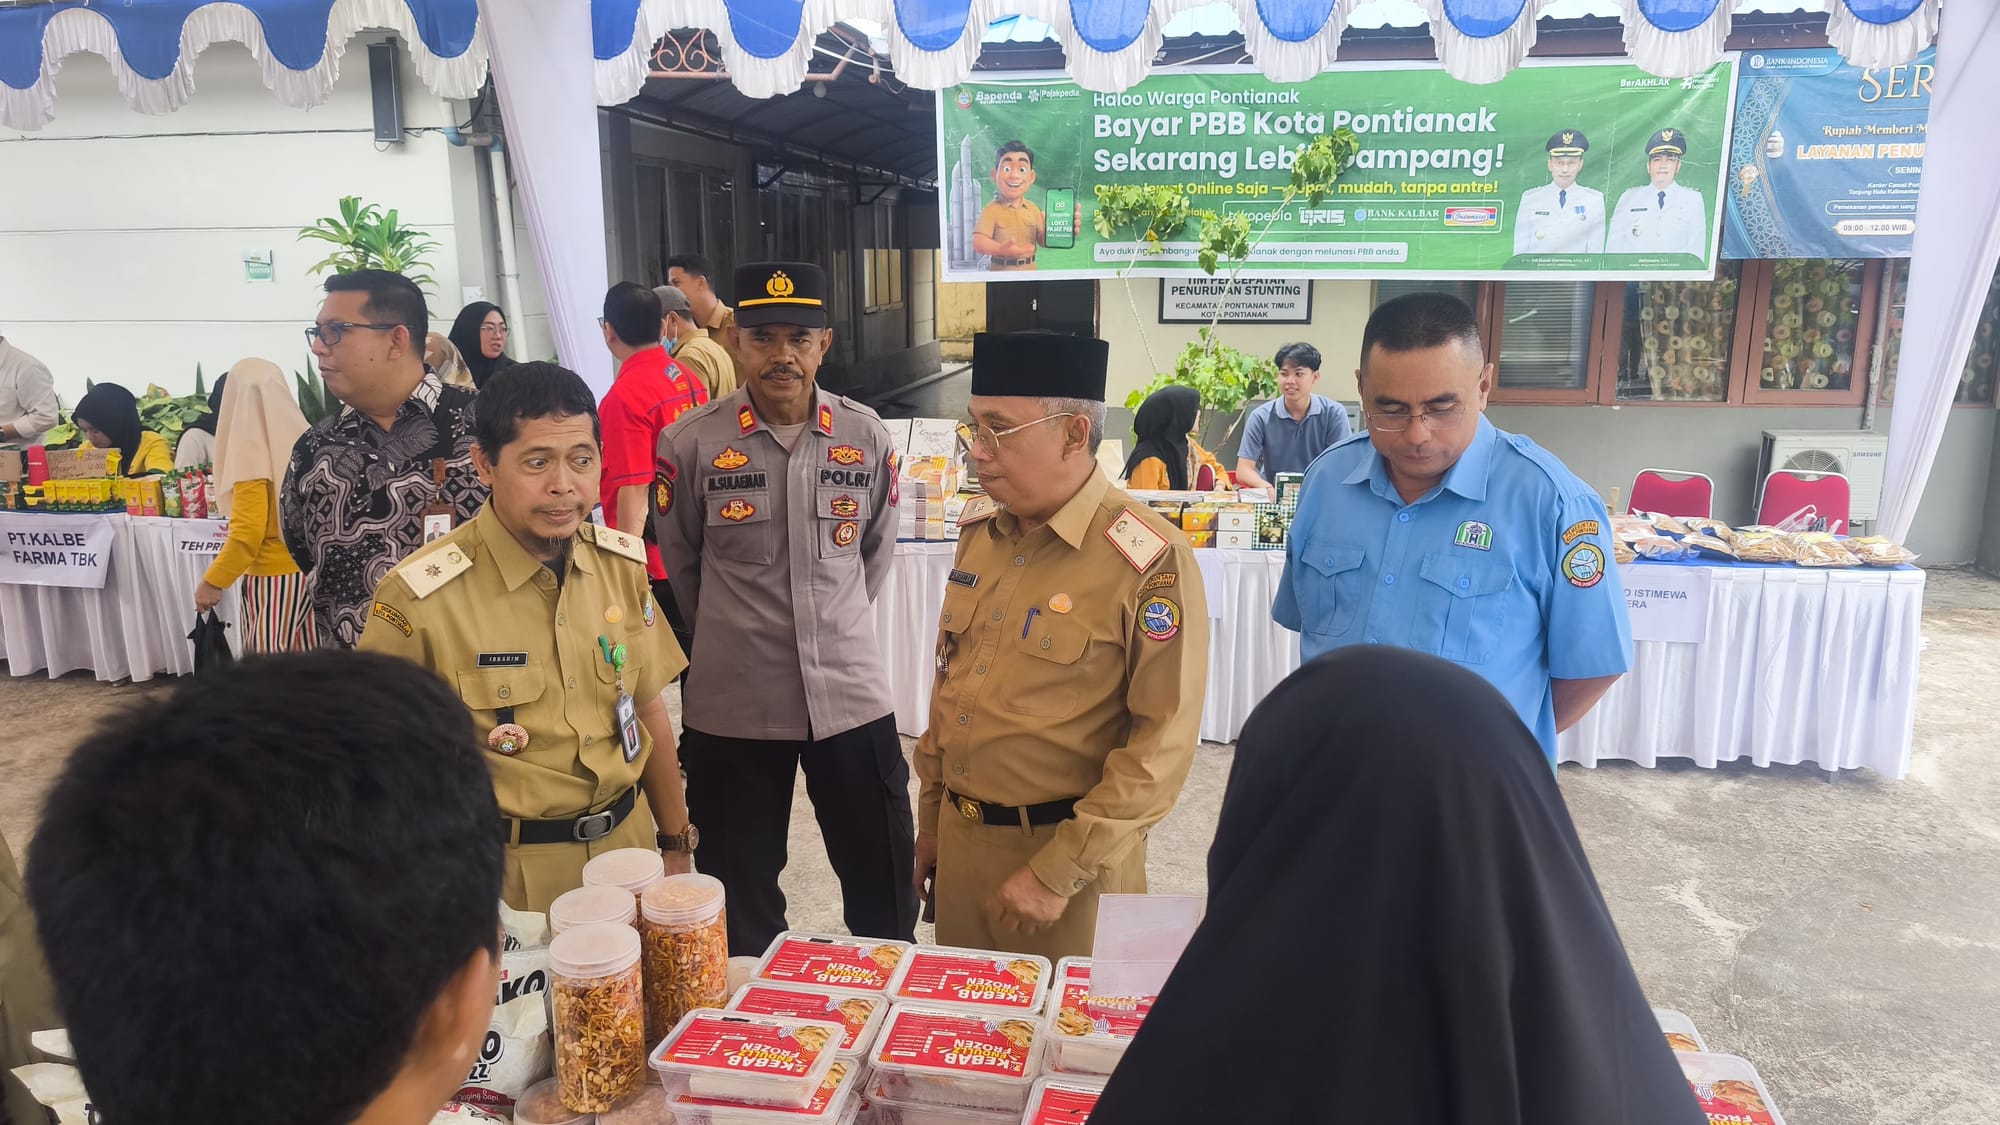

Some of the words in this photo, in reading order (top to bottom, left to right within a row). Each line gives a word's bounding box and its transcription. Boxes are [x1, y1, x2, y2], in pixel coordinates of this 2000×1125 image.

[1787, 57, 1829, 65] INDONESIA
[1619, 78, 1671, 87] BerAKHLAK
[975, 91, 1023, 103] Bapenda
[1093, 92, 1143, 107] Haloo
[1147, 91, 1206, 109] Warga
[1210, 89, 1300, 104] Pontianak
[1094, 114, 1183, 145] Bayar
[1190, 111, 1247, 136] PBB
[1254, 111, 1325, 135] Kota
[1333, 106, 1497, 133] Pontianak
[1823, 125, 1862, 137] Rupiah
[1864, 124, 1914, 135] Memberi
[1796, 143, 1875, 159] LAYANAN
[1094, 147, 1238, 179] Sekarang
[1186, 183, 1234, 196] Online
[1236, 183, 1268, 198] Saja
[1338, 181, 1398, 196] mudah,
[1401, 181, 1448, 197] tanpa
[1450, 181, 1499, 194] antre!
[1300, 209, 1345, 226] QRIS
[1367, 209, 1395, 217] BANK
[1398, 209, 1440, 217] KALBAR
[1099, 248, 1116, 256] Ayo
[1280, 248, 1313, 258] dengan
[1315, 247, 1356, 256] melunasi
[1357, 248, 1374, 256] PBB
[1376, 248, 1400, 256] anda
[1171, 286, 1242, 295] PENURUNAN
[1244, 286, 1301, 295] STUNTING
[820, 469, 872, 488] POLRI
[7, 532, 86, 547] PT.KALBE
[181, 541, 205, 551] TEH
[13, 550, 67, 566] FARMA
[70, 552, 98, 567] TBK
[1634, 589, 1688, 600] ISTIMEWA
[827, 962, 878, 975] FROZEN
[817, 973, 874, 986] KEBAB
[966, 977, 1020, 990] FROZEN
[958, 989, 1018, 1002] KEBAB
[1078, 1000, 1137, 1011] FROZEN
[740, 1042, 800, 1057] FROZEN
[951, 1046, 1008, 1059] ENDULLZ
[953, 1038, 1012, 1054] FROZEN
[737, 1049, 794, 1062] ENDULLZ
[944, 1052, 1010, 1070] KEBAB
[728, 1055, 794, 1071] KEBAB
[482, 1089, 499, 1102] Sapi
